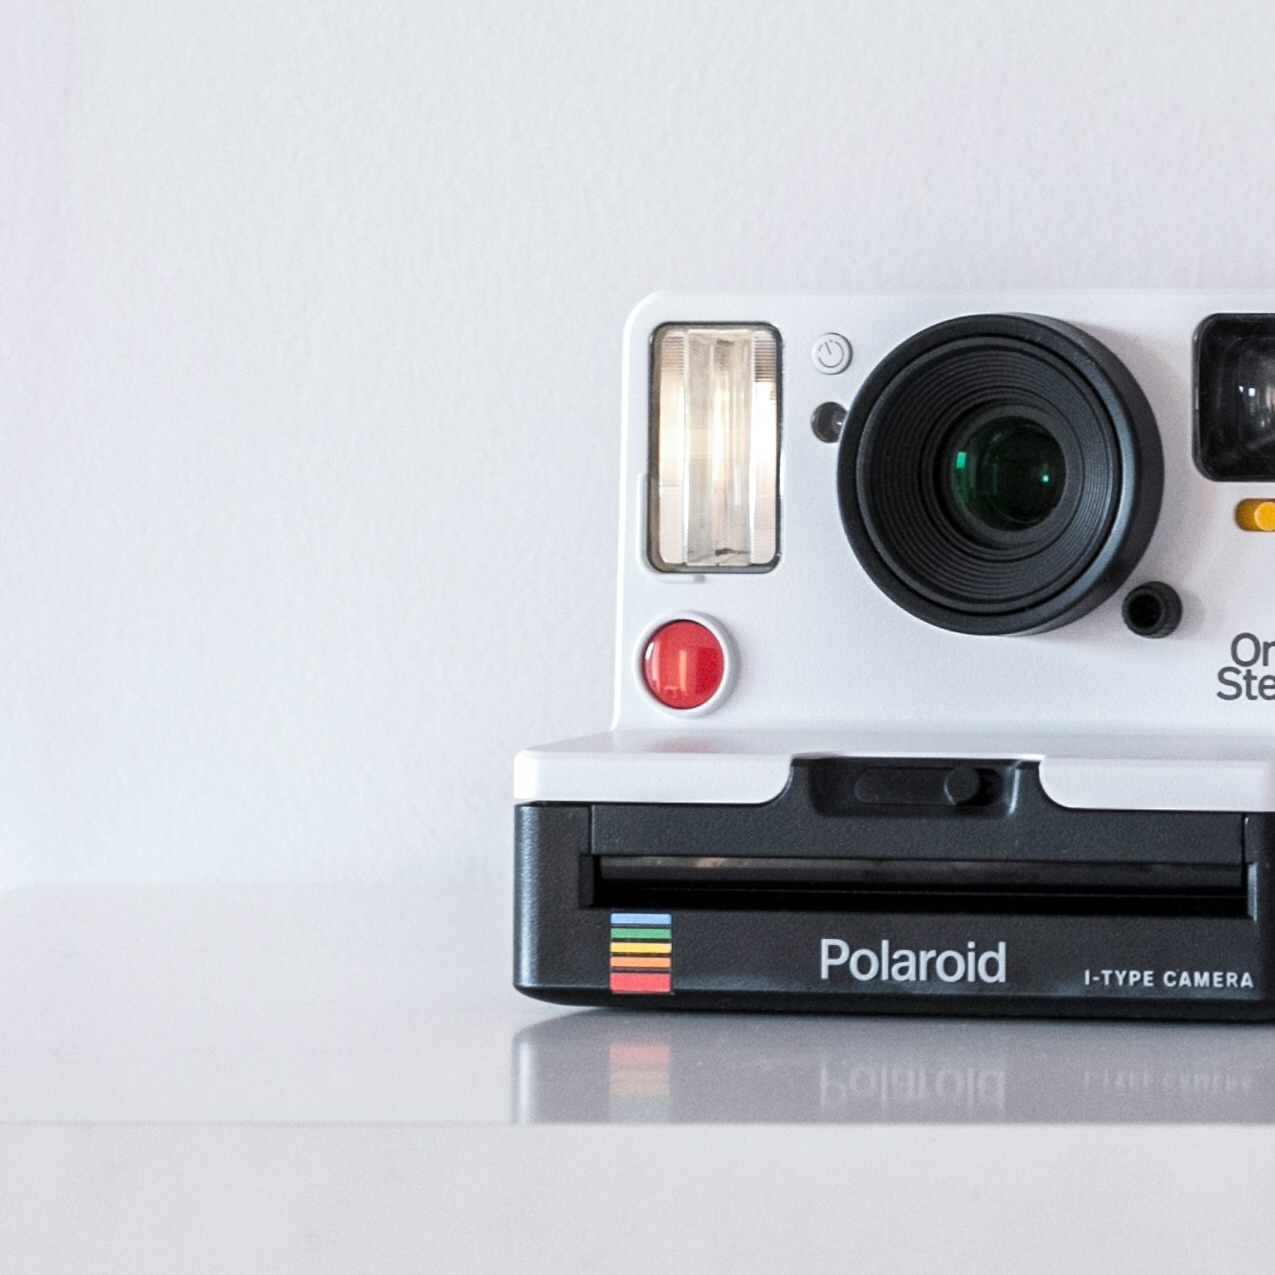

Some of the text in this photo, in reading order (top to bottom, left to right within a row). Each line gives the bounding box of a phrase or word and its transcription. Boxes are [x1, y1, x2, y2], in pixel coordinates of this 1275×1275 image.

[820, 938, 1006, 983] Polaroid
[1084, 969, 1253, 988] I-TYPE CAMERA
